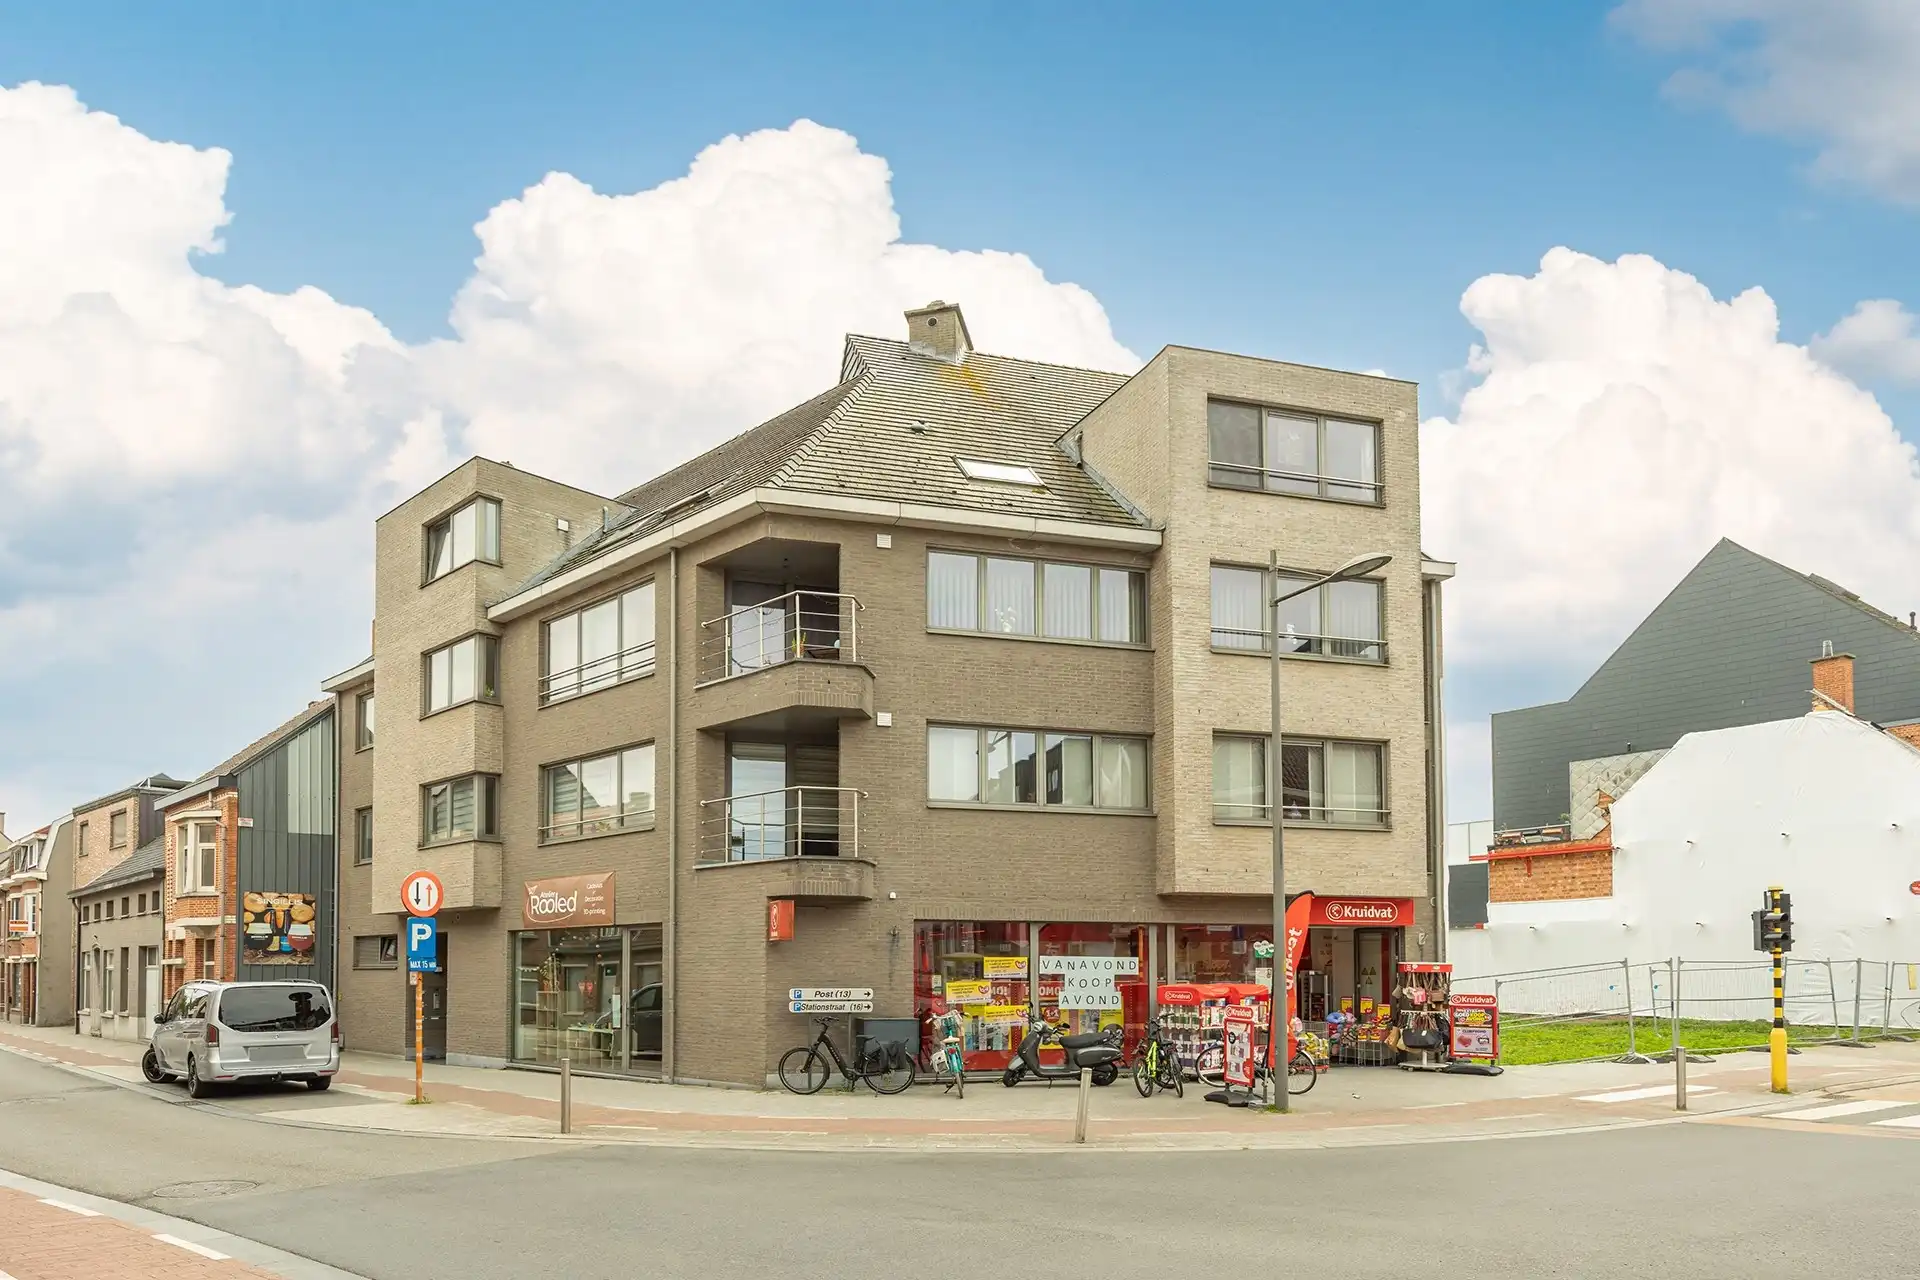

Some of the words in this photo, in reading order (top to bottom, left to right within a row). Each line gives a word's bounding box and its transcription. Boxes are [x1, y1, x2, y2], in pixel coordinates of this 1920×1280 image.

[530, 890, 578, 915] Rooled
[1343, 906, 1393, 918] Kruidvat
[411, 923, 432, 951] P
[410, 961, 421, 969] MAX
[1042, 960, 1137, 970] VANAVOND
[1068, 978, 1112, 988] KOOP
[814, 990, 834, 998] Post
[835, 990, 852, 998] (13)
[1061, 995, 1119, 1005] AVOND
[1461, 996, 1494, 1004] Kruidvat
[800, 1003, 846, 1011] Stationstraat
[850, 1003, 864, 1011] (16)
